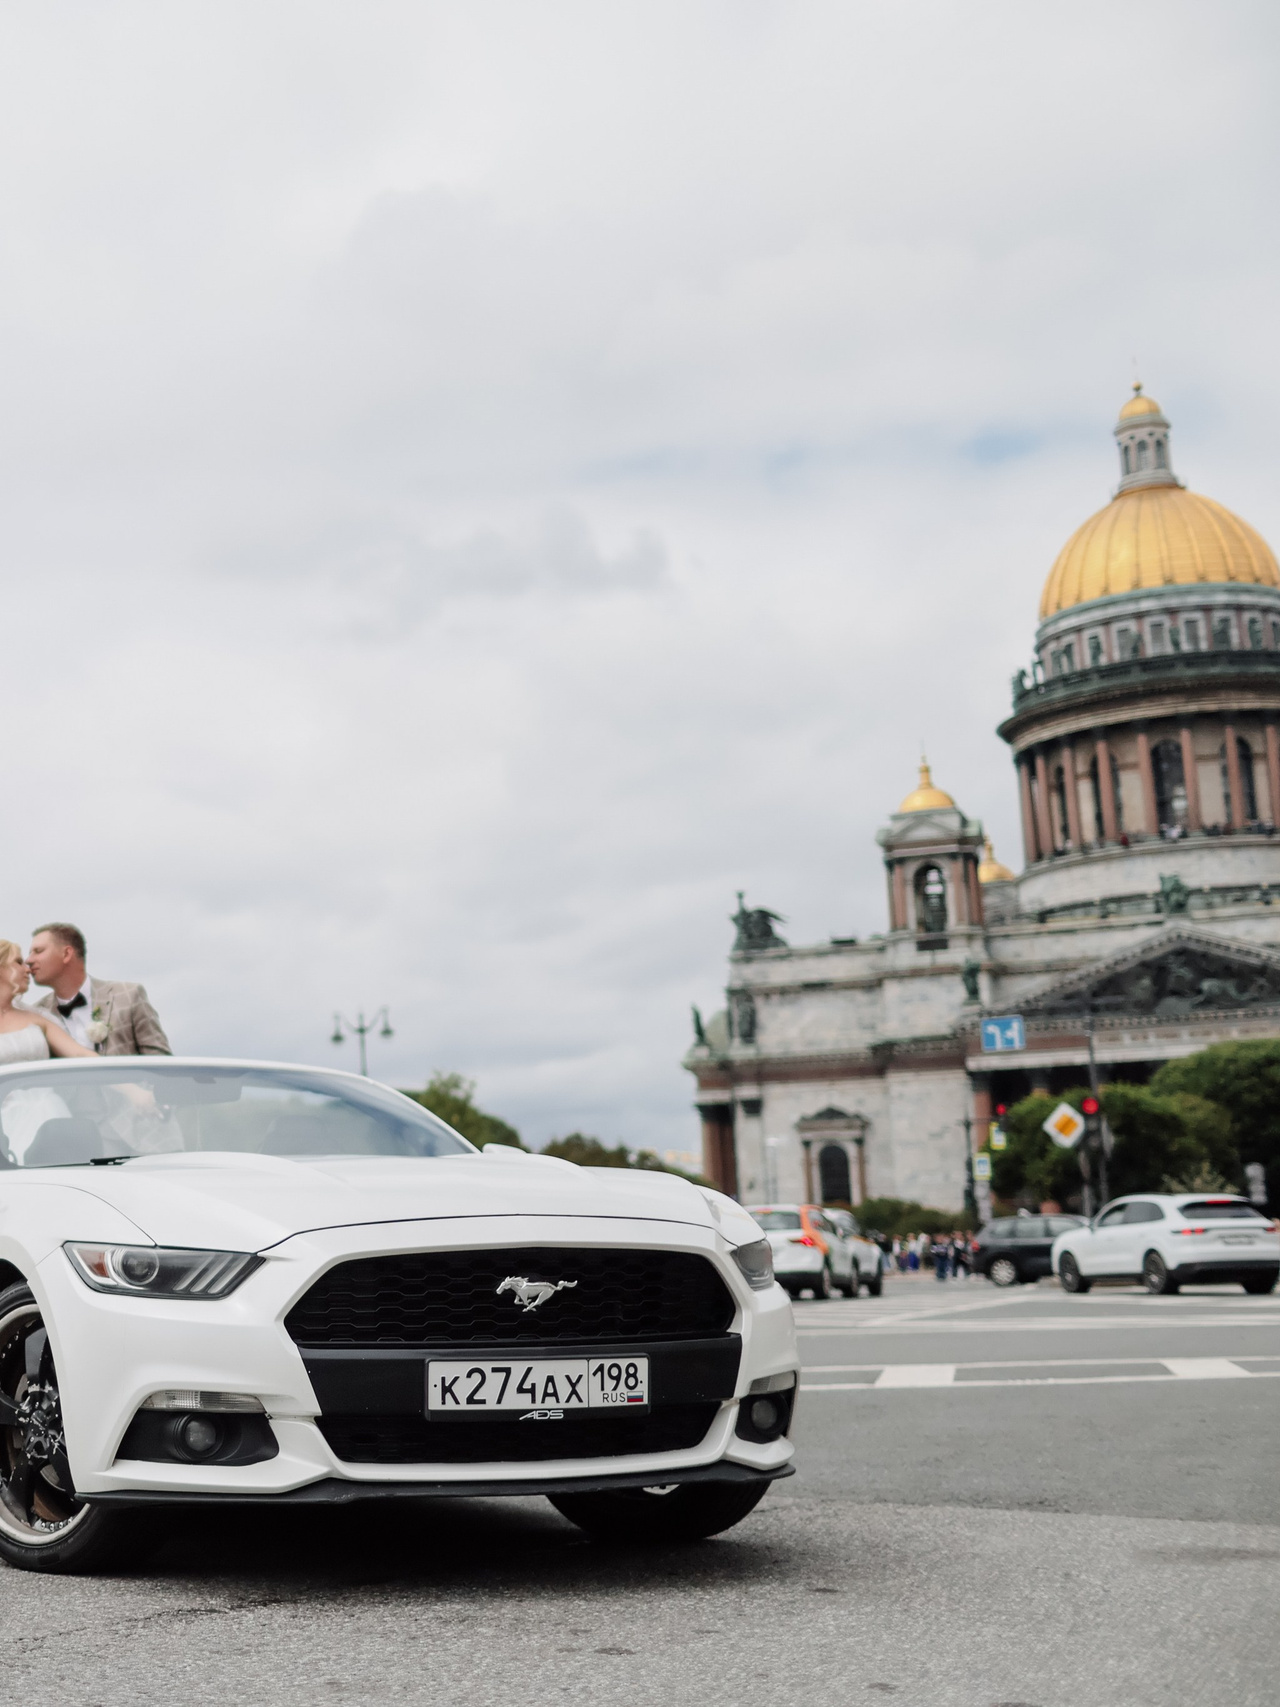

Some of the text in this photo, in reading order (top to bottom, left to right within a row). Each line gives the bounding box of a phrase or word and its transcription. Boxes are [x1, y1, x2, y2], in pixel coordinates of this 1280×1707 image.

[591, 1362, 639, 1392] 198
[602, 1391, 626, 1403] RUS
[519, 1409, 564, 1420] ADS
